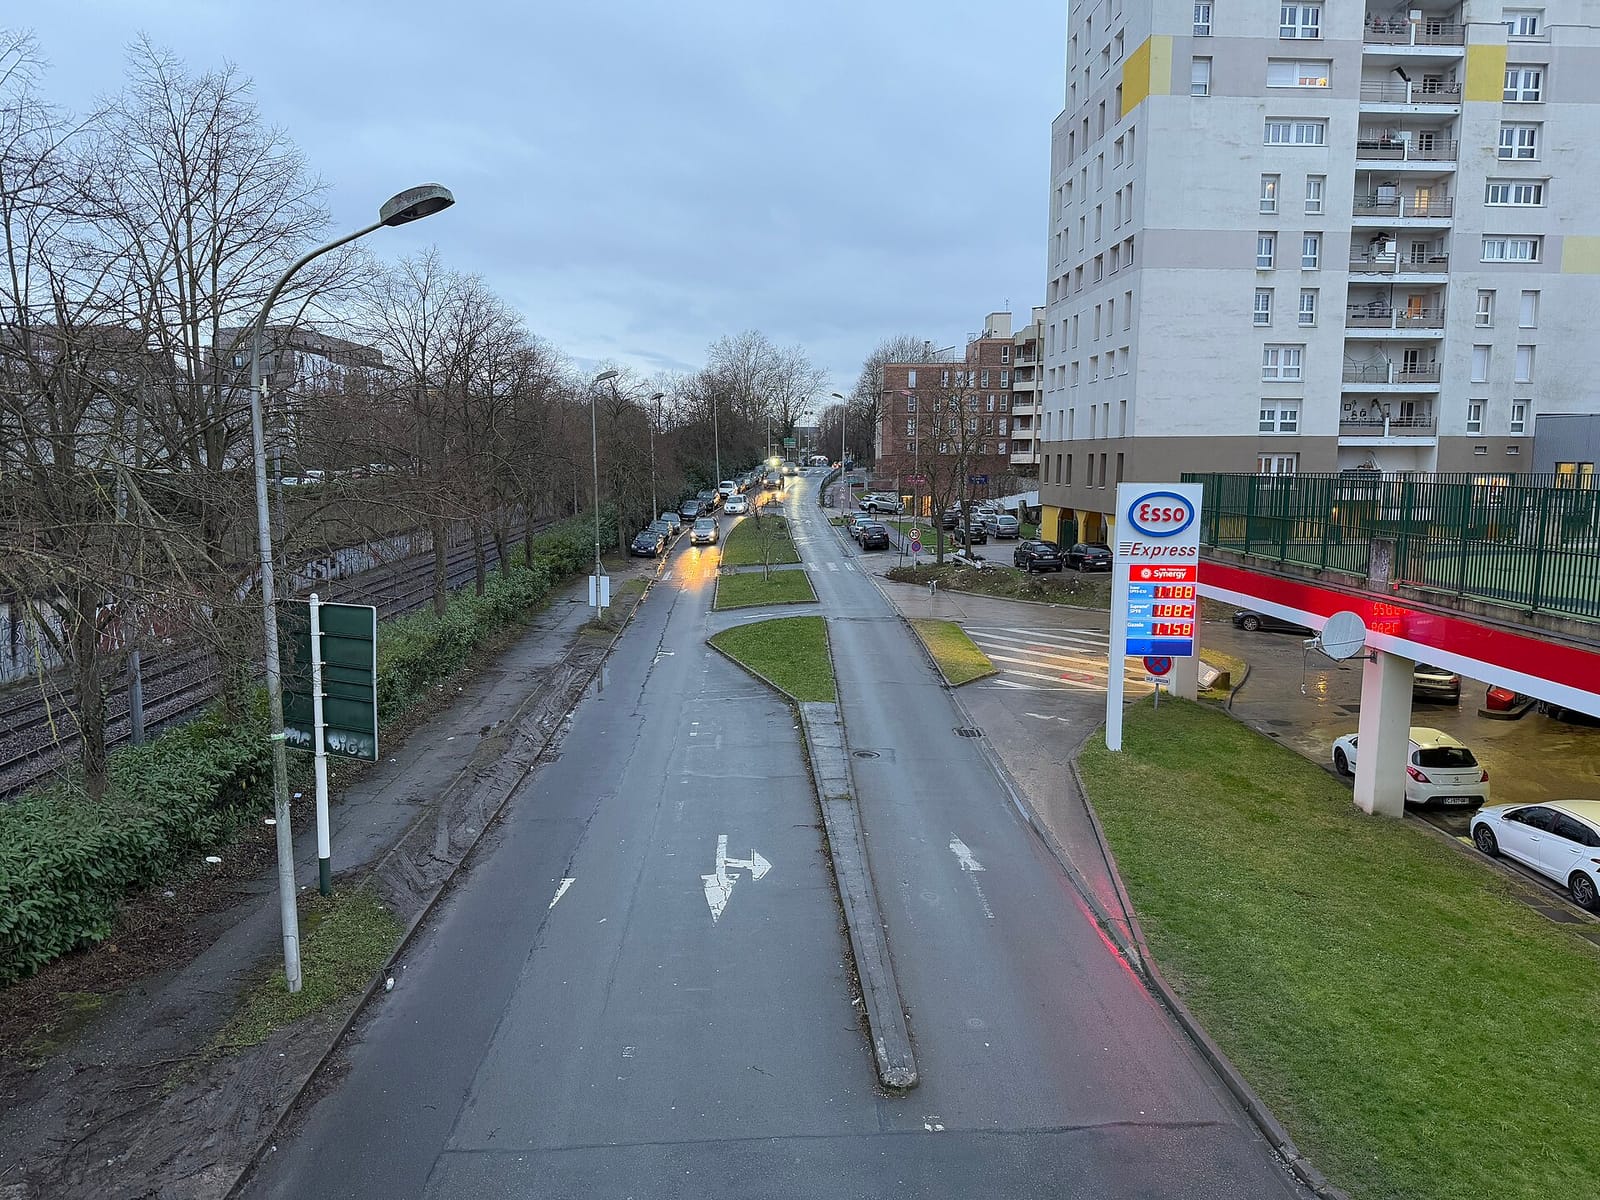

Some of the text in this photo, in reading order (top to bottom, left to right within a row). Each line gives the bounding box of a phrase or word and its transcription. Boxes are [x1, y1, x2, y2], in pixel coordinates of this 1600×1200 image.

[1139, 503, 1185, 522] Esso
[1130, 542, 1196, 559] Express
[1153, 569, 1186, 579] Synergy
[1158, 586, 1193, 598] 1.788
[1157, 604, 1192, 617] 1.882
[1156, 622, 1191, 635] 1.758
